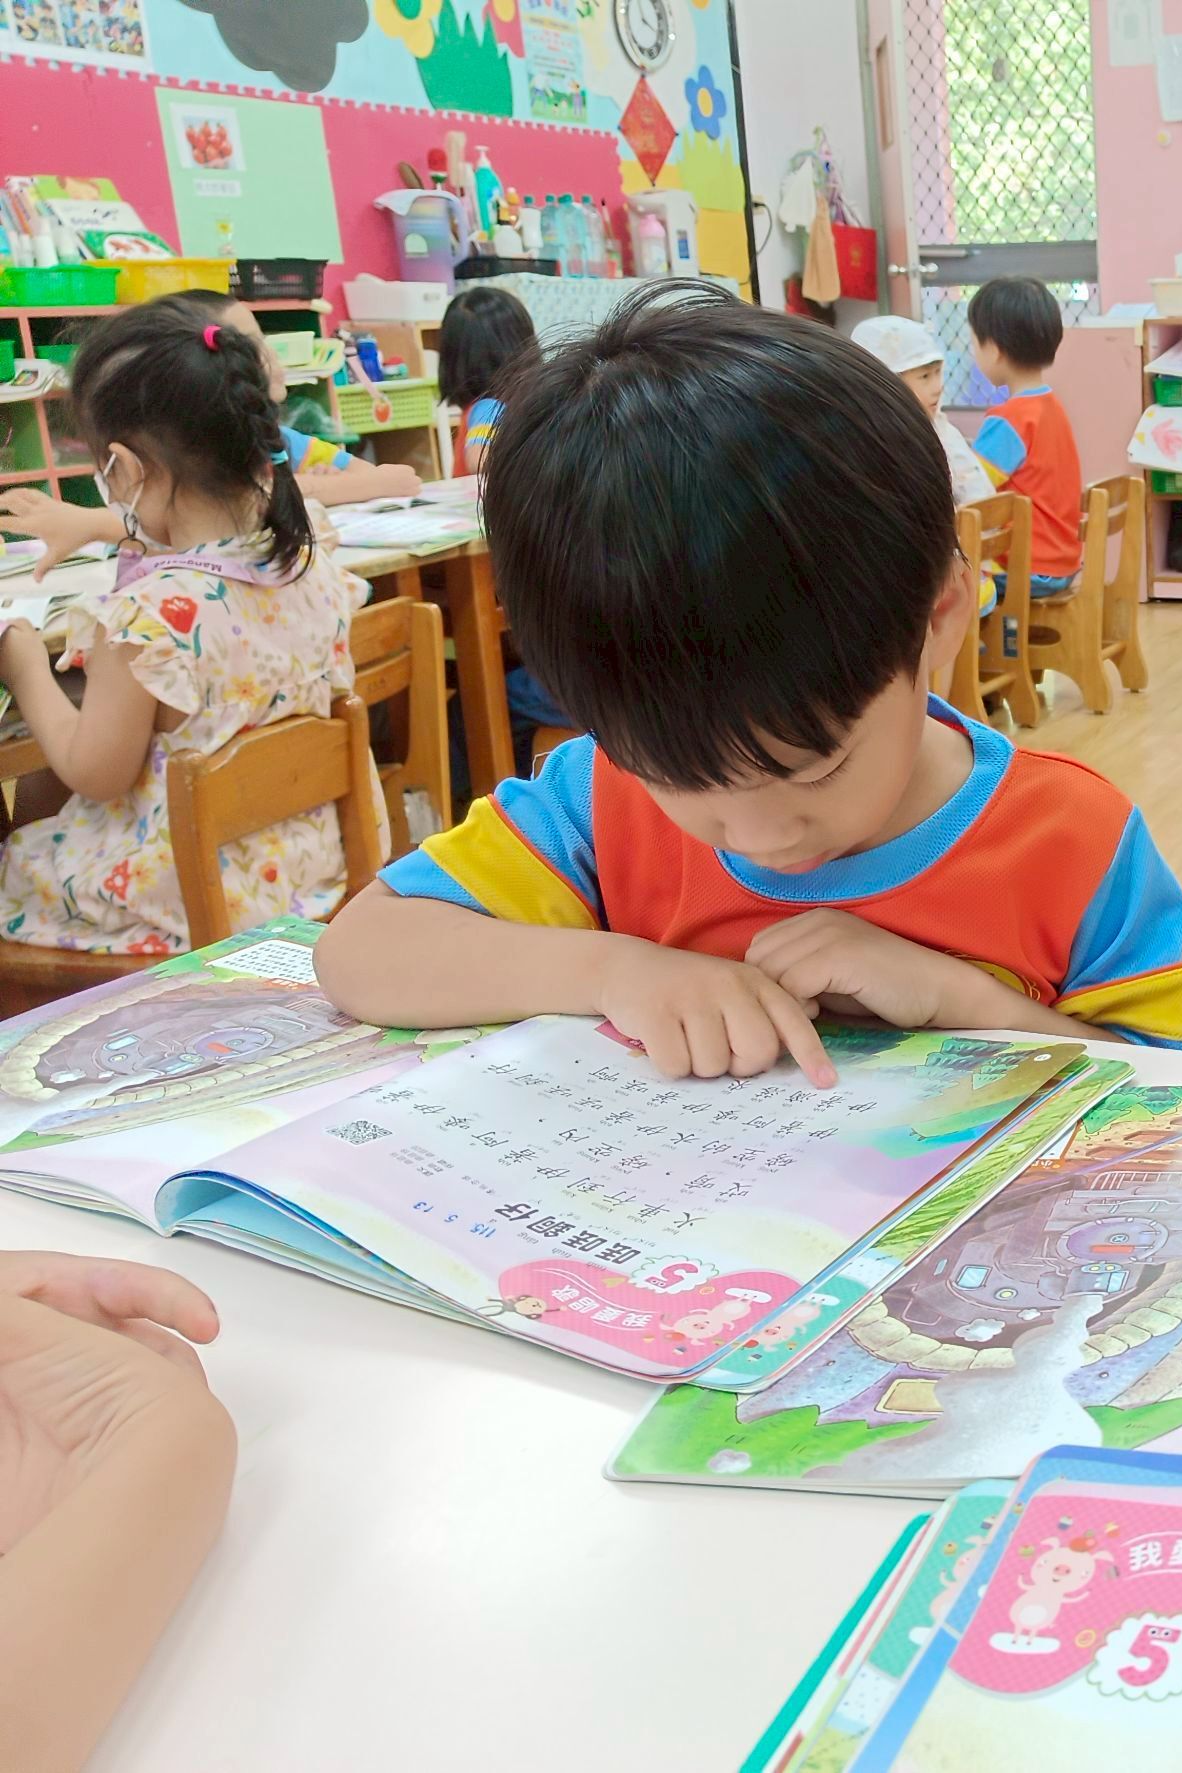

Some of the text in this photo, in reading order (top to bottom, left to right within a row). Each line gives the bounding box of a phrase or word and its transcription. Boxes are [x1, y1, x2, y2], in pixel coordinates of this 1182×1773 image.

[644, 1262, 699, 1289] 5
[549, 1283, 654, 1329] 我愛唱歌
[1117, 1624, 1182, 1687] 5
